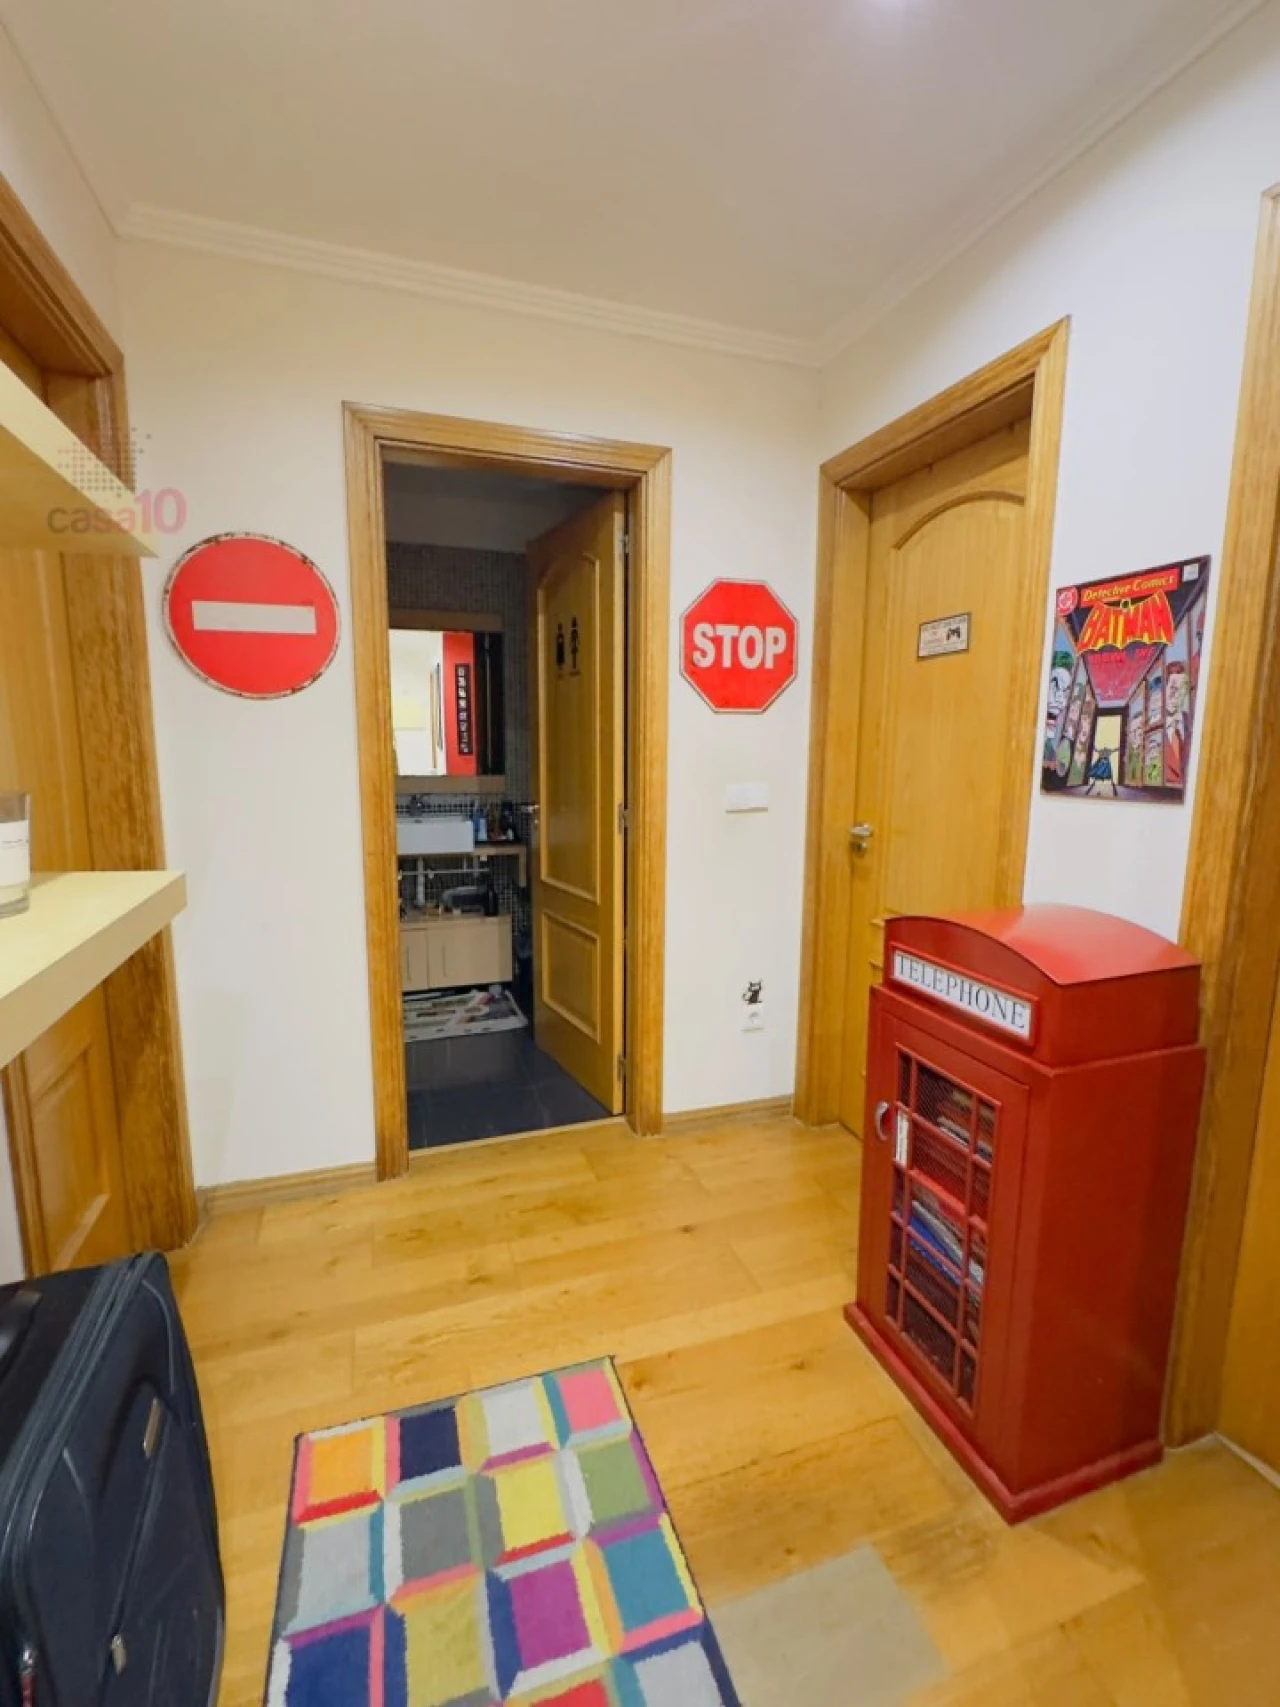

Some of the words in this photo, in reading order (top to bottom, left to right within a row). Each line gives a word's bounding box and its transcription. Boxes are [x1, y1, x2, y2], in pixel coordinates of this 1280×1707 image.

[1084, 584, 1131, 602] Detective
[1133, 575, 1175, 592] Comics
[692, 621, 787, 669] STOP
[1077, 589, 1175, 656] BATMAN
[898, 953, 1026, 1030] TELEPHONE
